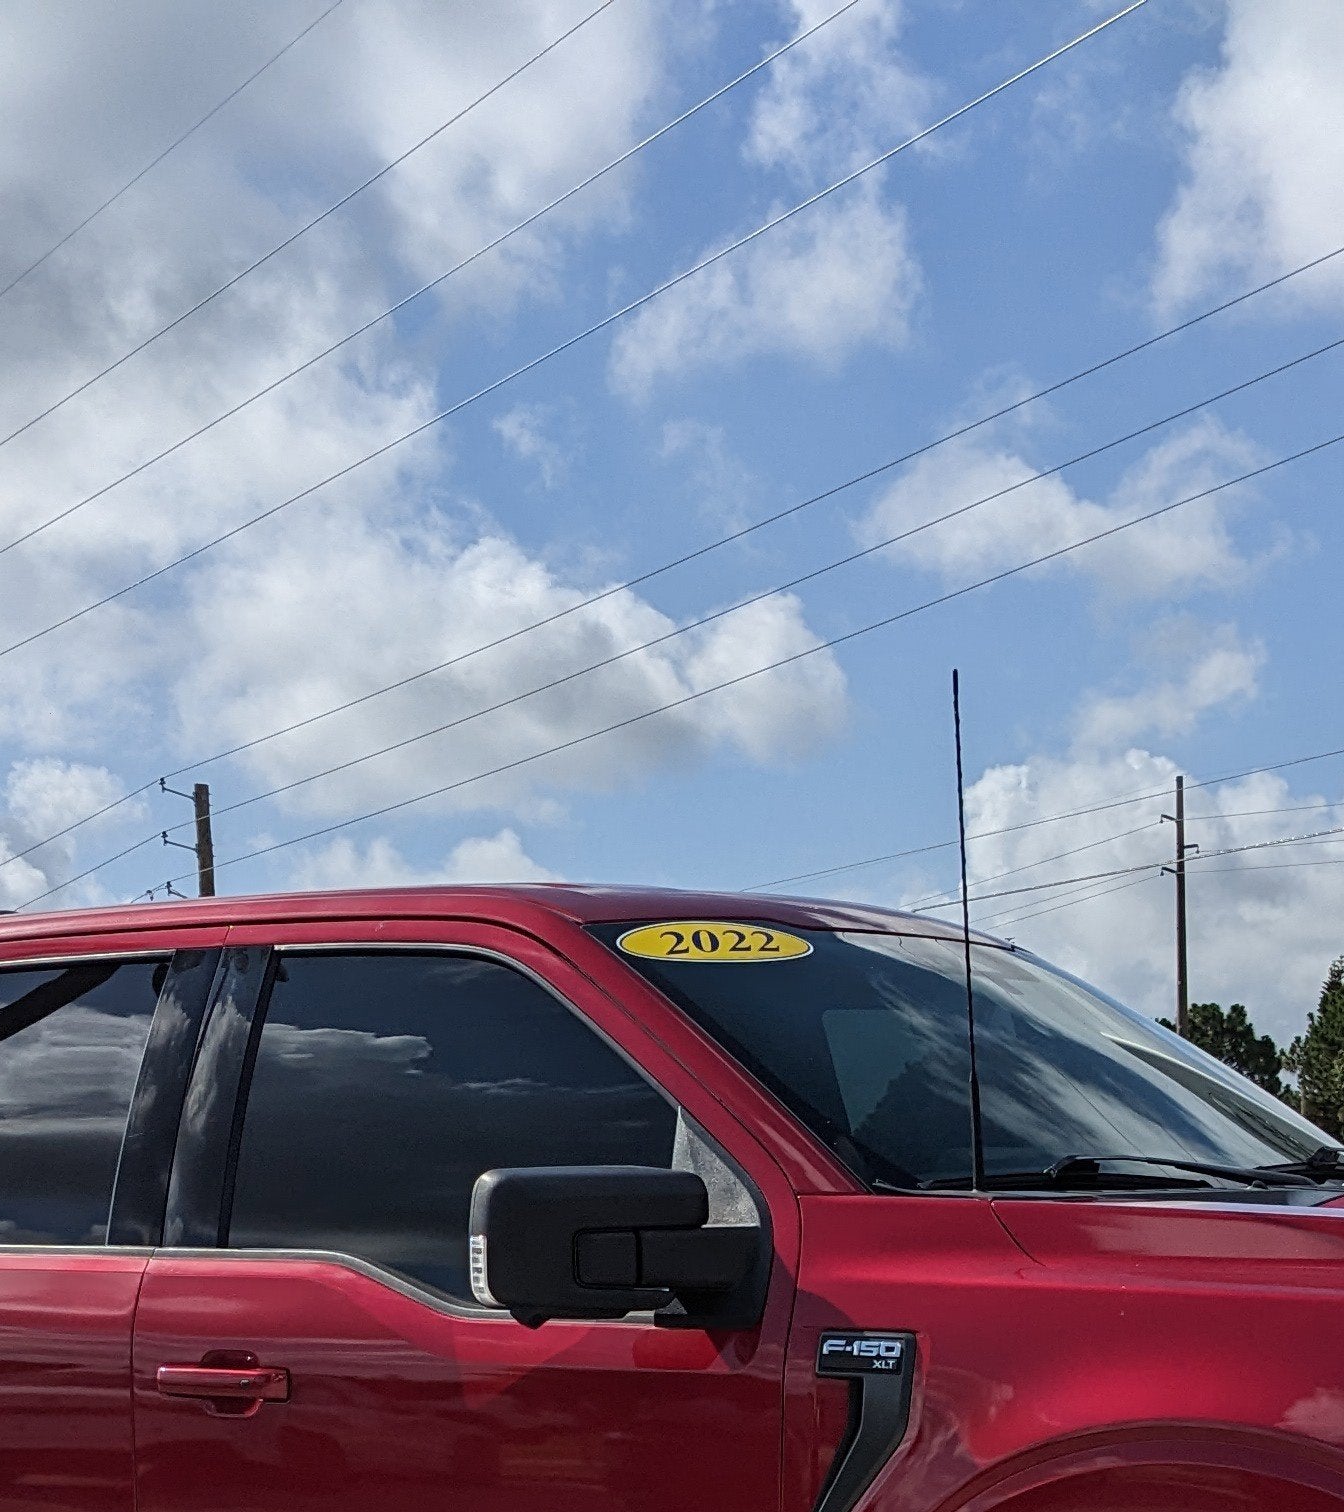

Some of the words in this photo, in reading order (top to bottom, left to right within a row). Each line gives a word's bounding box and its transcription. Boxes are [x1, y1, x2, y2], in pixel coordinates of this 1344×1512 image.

[659, 929, 780, 956] 2022
[822, 1339, 902, 1358] F-150
[872, 1360, 897, 1369] XLT
